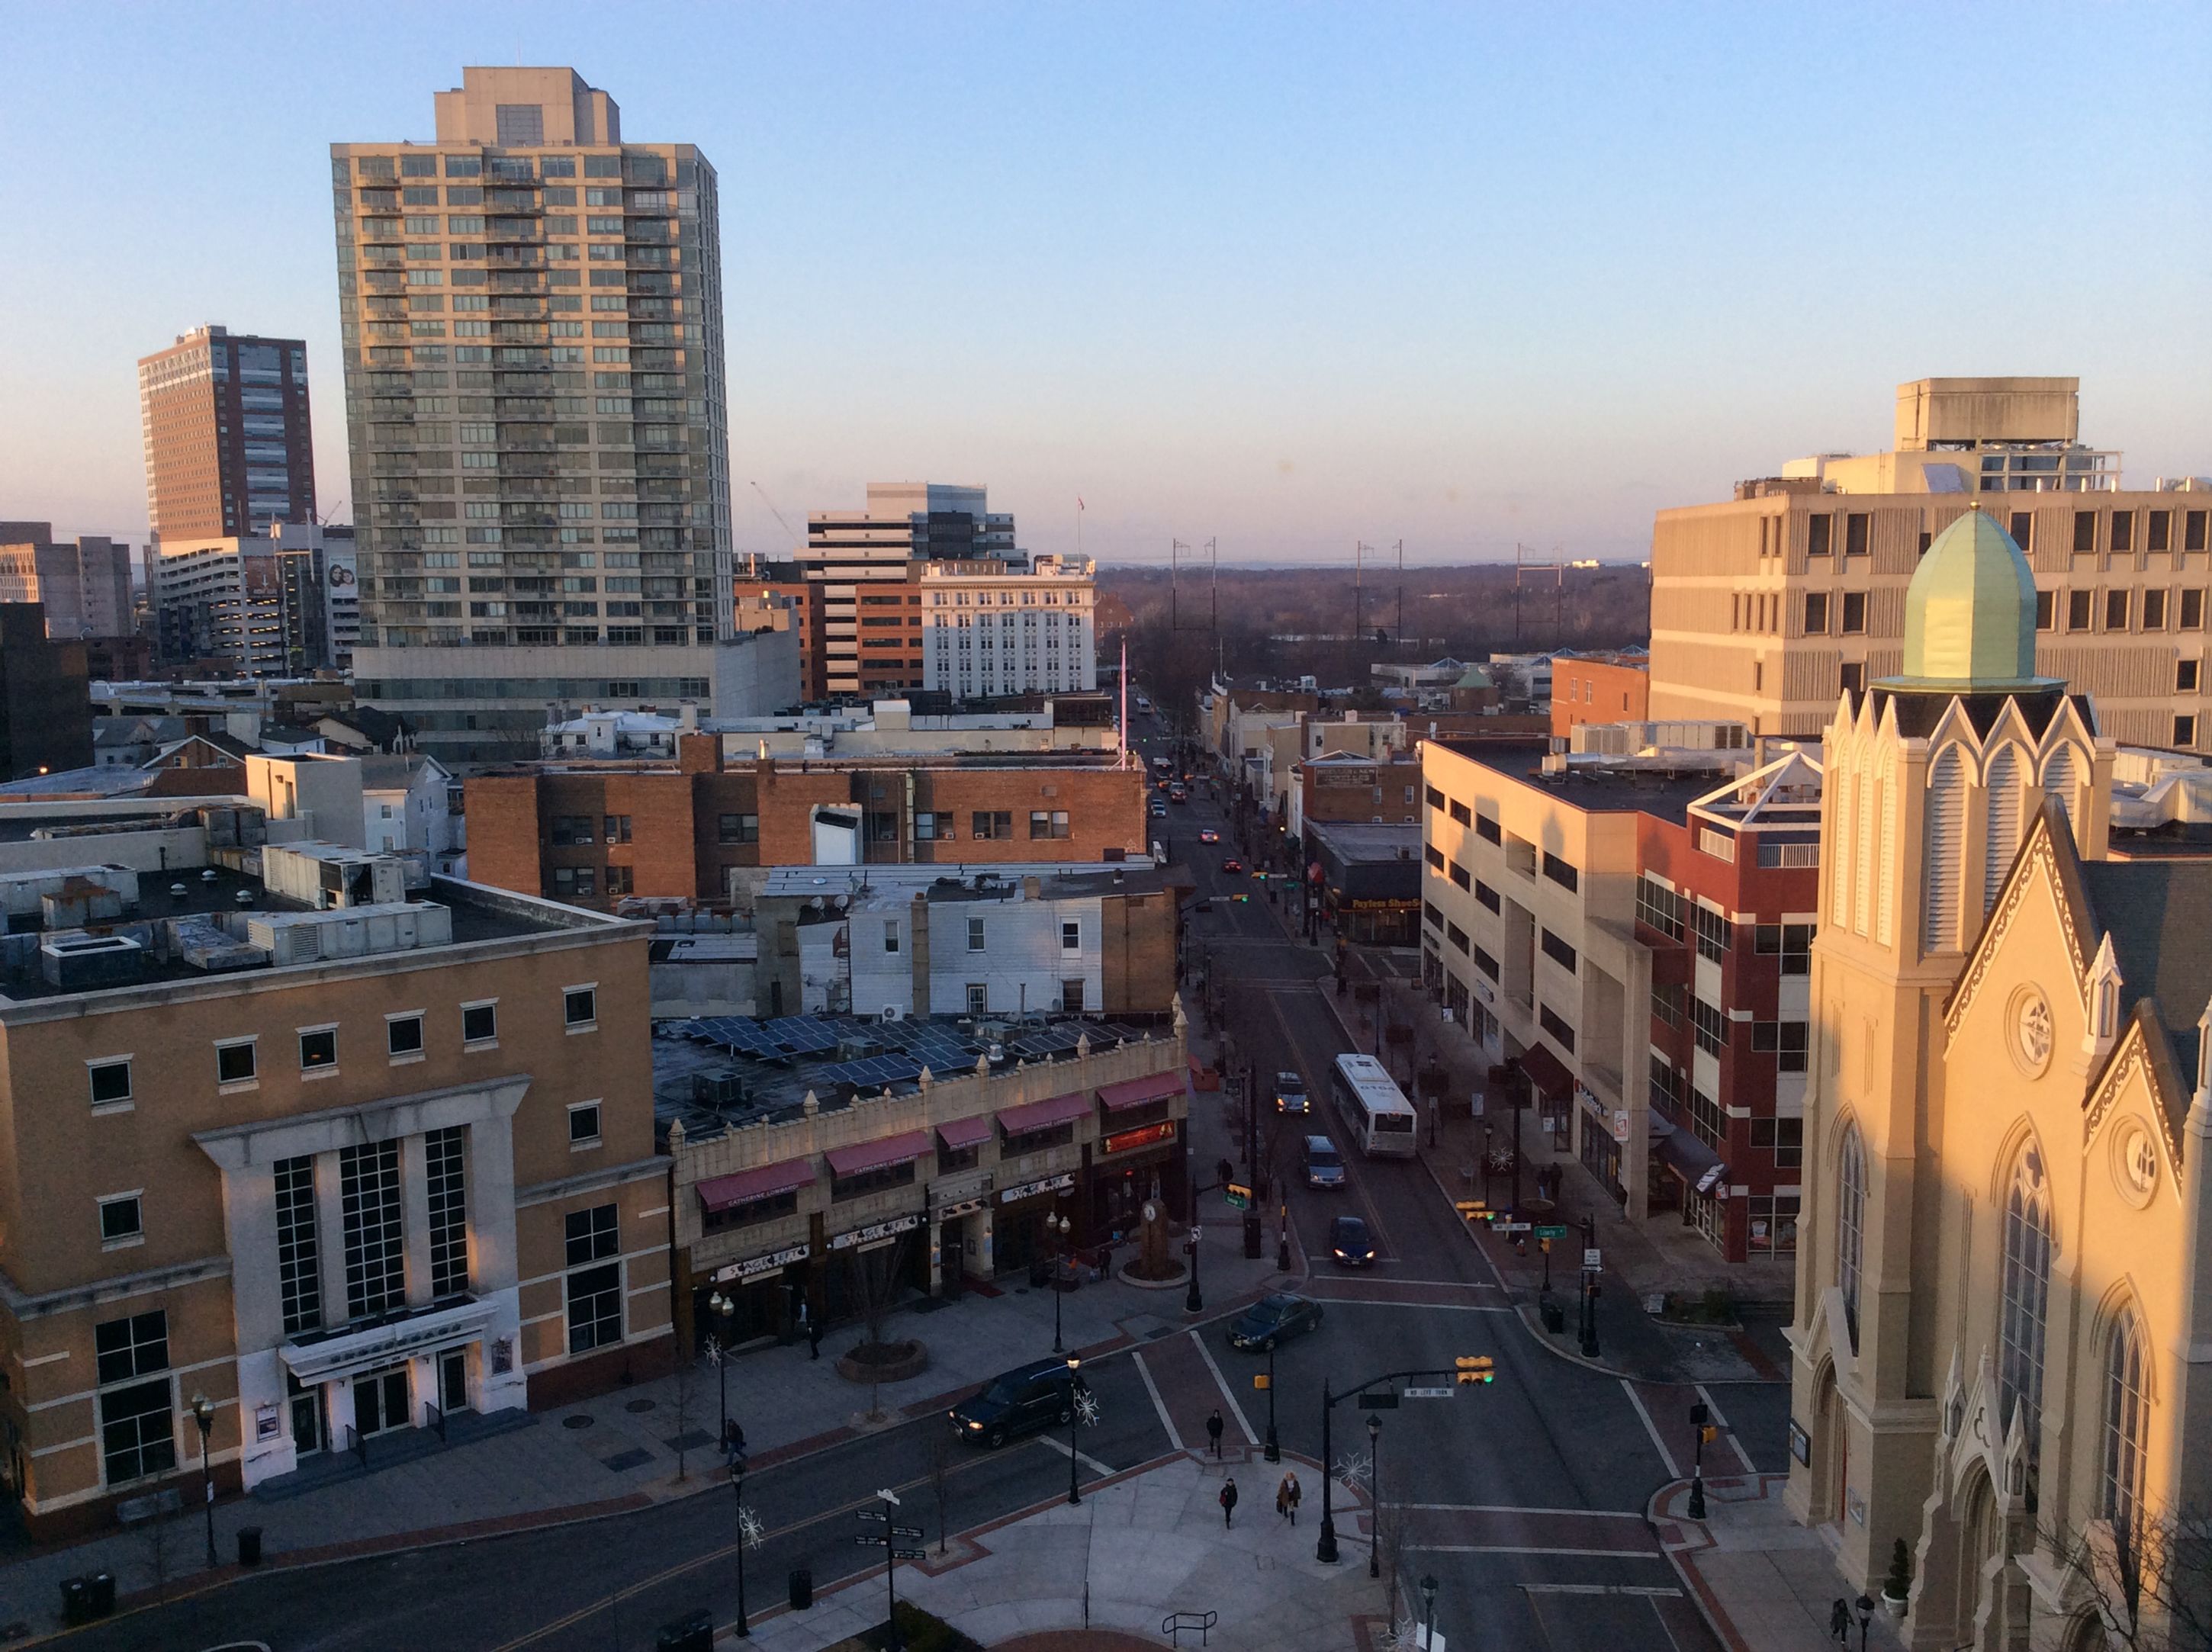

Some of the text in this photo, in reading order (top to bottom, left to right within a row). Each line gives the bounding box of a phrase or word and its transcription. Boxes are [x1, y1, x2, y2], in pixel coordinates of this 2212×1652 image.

[1352, 899, 1386, 909] Payless
[854, 1154, 919, 1175] CATHERINE LOMBARDI
[728, 1184, 799, 1207] CATHERINE LOMBARDI
[730, 1258, 767, 1274] SAGE
